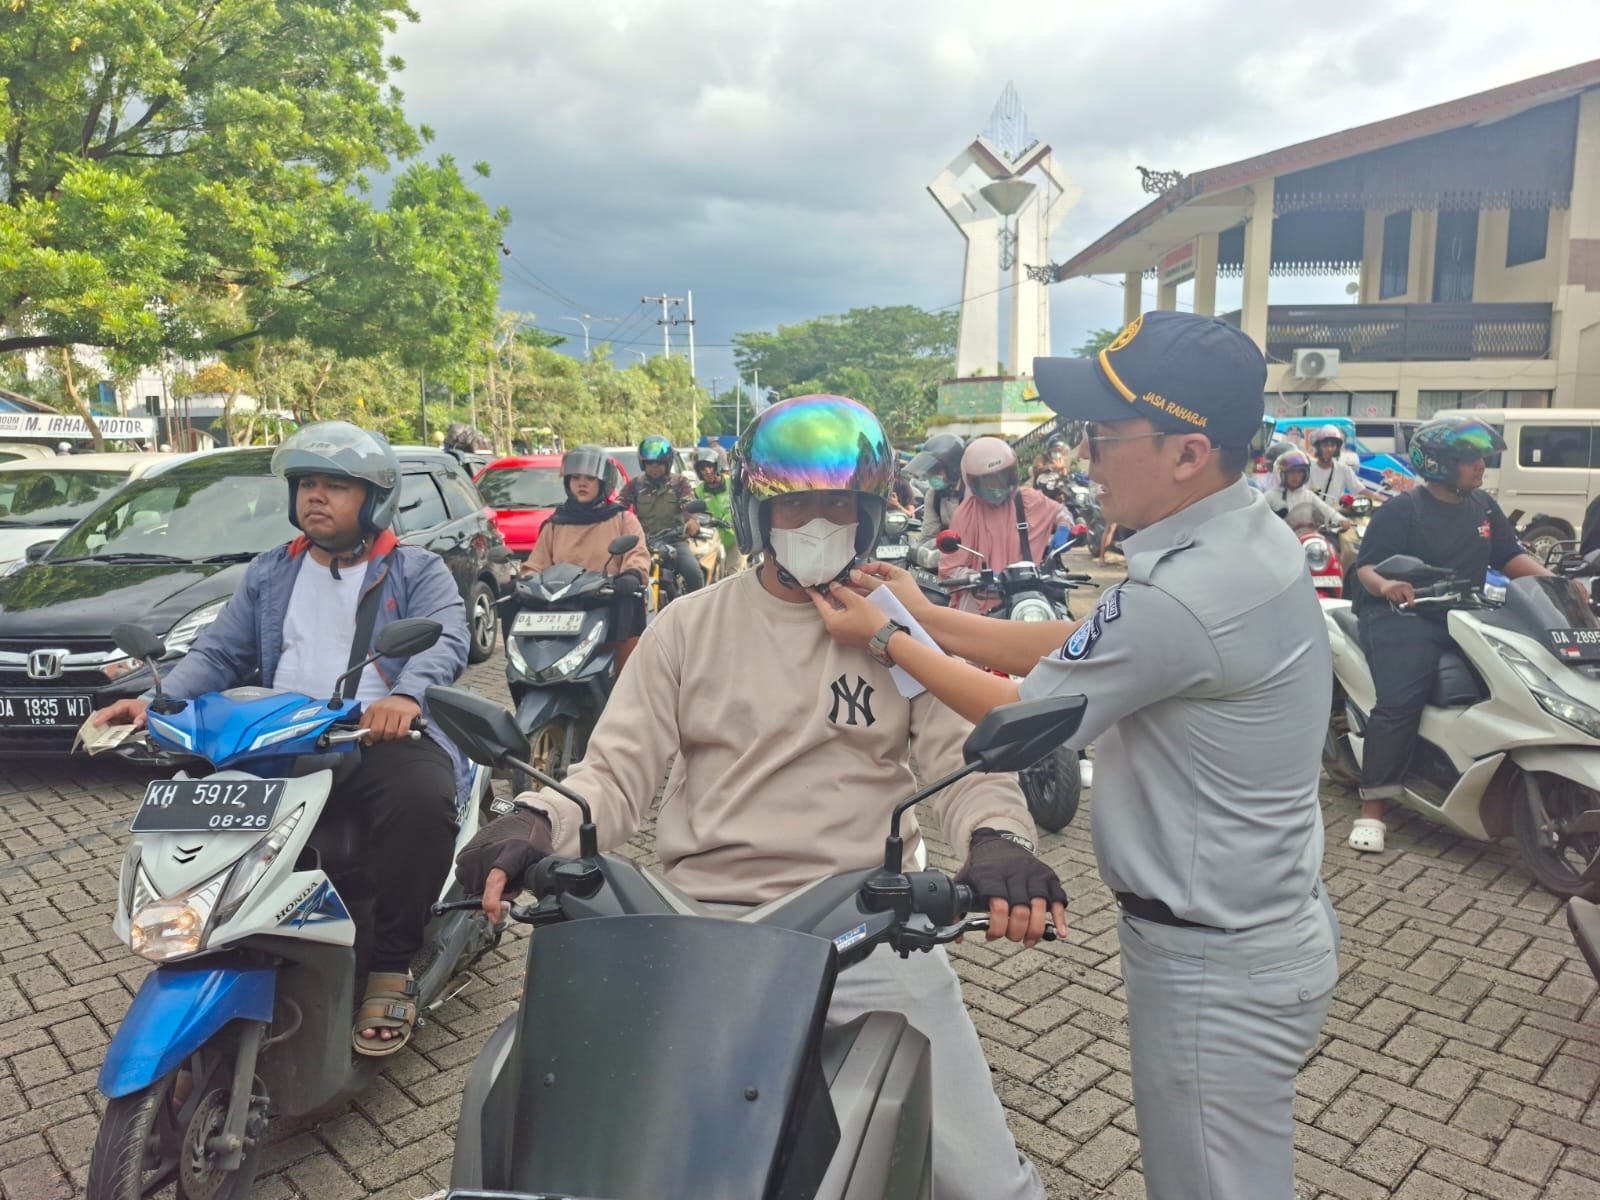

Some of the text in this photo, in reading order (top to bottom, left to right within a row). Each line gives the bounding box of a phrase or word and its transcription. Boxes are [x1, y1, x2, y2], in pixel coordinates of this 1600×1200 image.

[1142, 391, 1208, 428] JASA RAHARJA
[99, 419, 143, 433] MOTOR
[1551, 631, 1570, 644] DA
[24, 699, 58, 716] 1835
[66, 699, 85, 716] WI
[828, 673, 876, 727] NY
[146, 784, 277, 805] KH 5912 Y
[275, 882, 318, 921] HONDA
